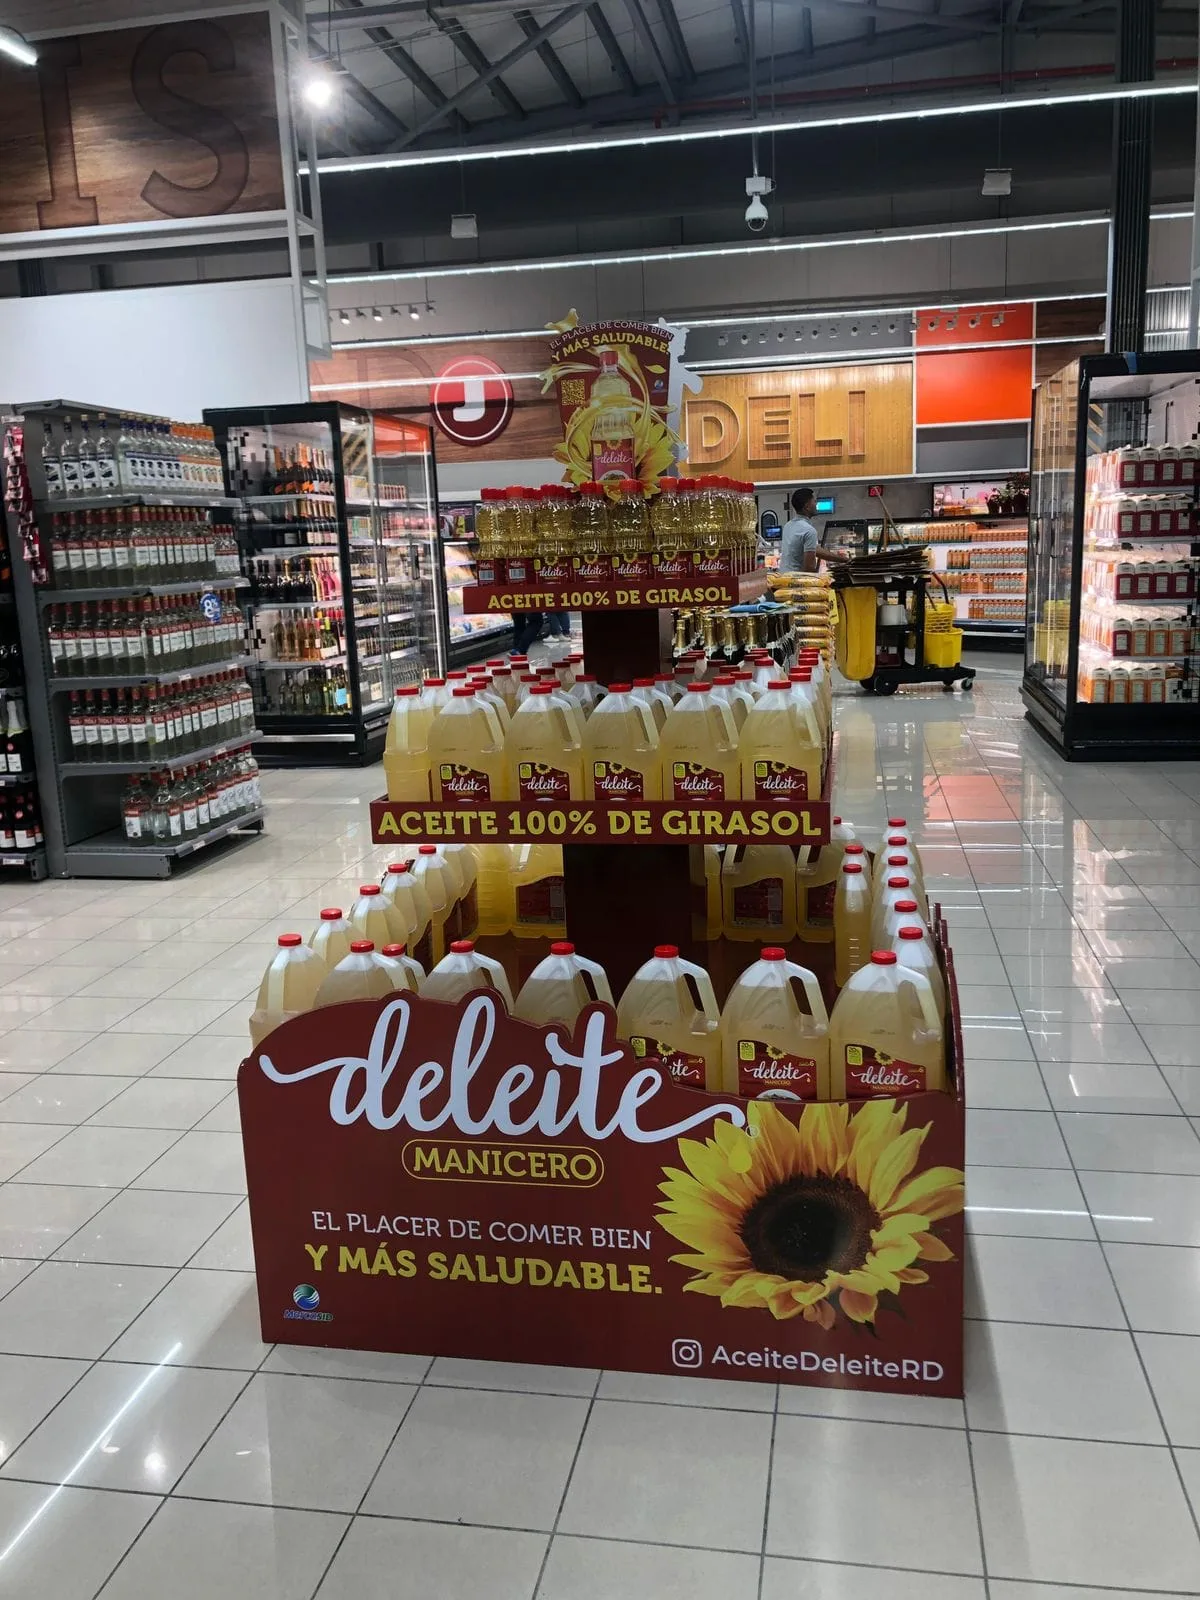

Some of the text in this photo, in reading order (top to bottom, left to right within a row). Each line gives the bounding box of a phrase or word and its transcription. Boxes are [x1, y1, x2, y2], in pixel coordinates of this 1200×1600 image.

[549, 320, 674, 350] EL PLACER DE COMER BIEN
[551, 352, 561, 362] Y
[562, 337, 590, 357] MÁS
[686, 390, 867, 465] DELI
[595, 450, 633, 464] deleite
[574, 563, 608, 577] deleite
[613, 562, 648, 575] deleite
[654, 560, 688, 573] deleite
[695, 559, 730, 572] deleite
[488, 586, 732, 610] ACEITE 100% DE GIRASOL
[442, 776, 488, 793] deleite
[520, 775, 568, 792] deleite
[594, 774, 641, 791] deleite
[674, 775, 722, 792] deleite
[756, 774, 806, 791] deleite
[378, 810, 822, 836] ACEITE 100% DE GIRASOL
[259, 995, 746, 1143] deleite
[743, 1060, 811, 1080] deleite
[851, 1066, 920, 1086] deleite
[413, 1147, 597, 1181] MANICERO
[312, 1210, 651, 1250] EL PLACER DE COMER BIEN
[305, 1241, 663, 1295] Y MÁS SALUDABLE.
[711, 1345, 944, 1382] AceiteDeleiteRD
